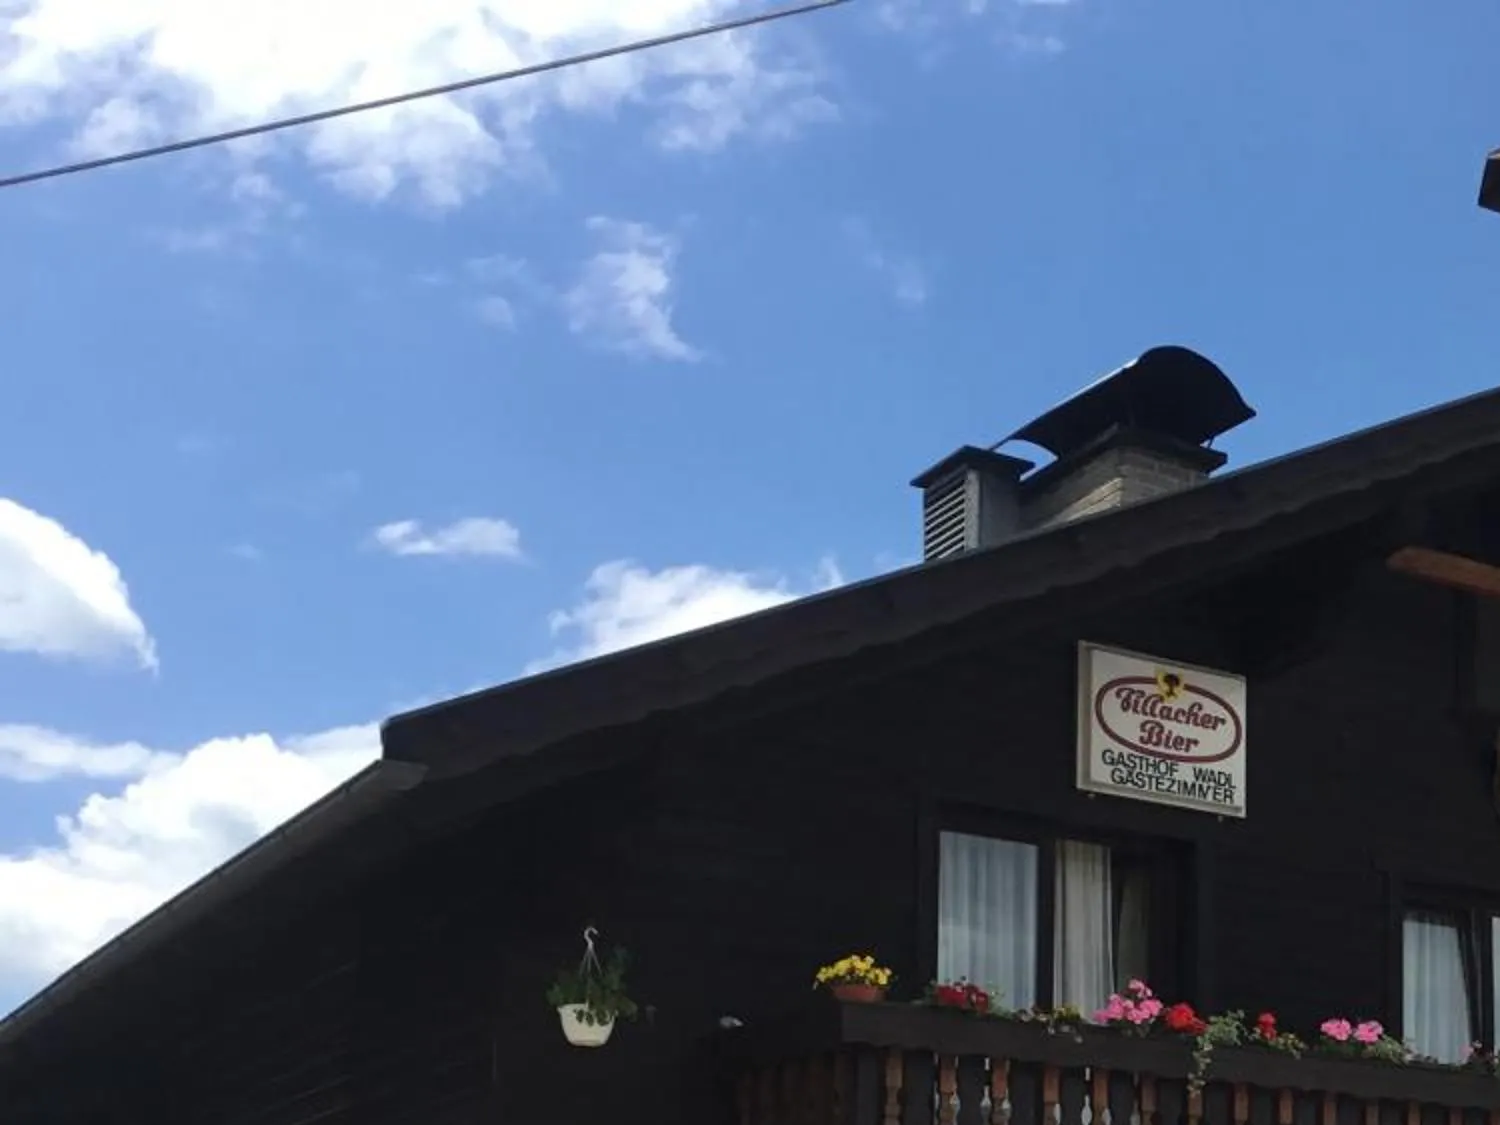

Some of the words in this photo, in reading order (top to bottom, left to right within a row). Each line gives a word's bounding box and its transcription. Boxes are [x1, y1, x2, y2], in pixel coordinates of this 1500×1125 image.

[1140, 720, 1200, 752] Bier
[1101, 749, 1179, 777] GASTHOF
[1192, 766, 1236, 789] WADL
